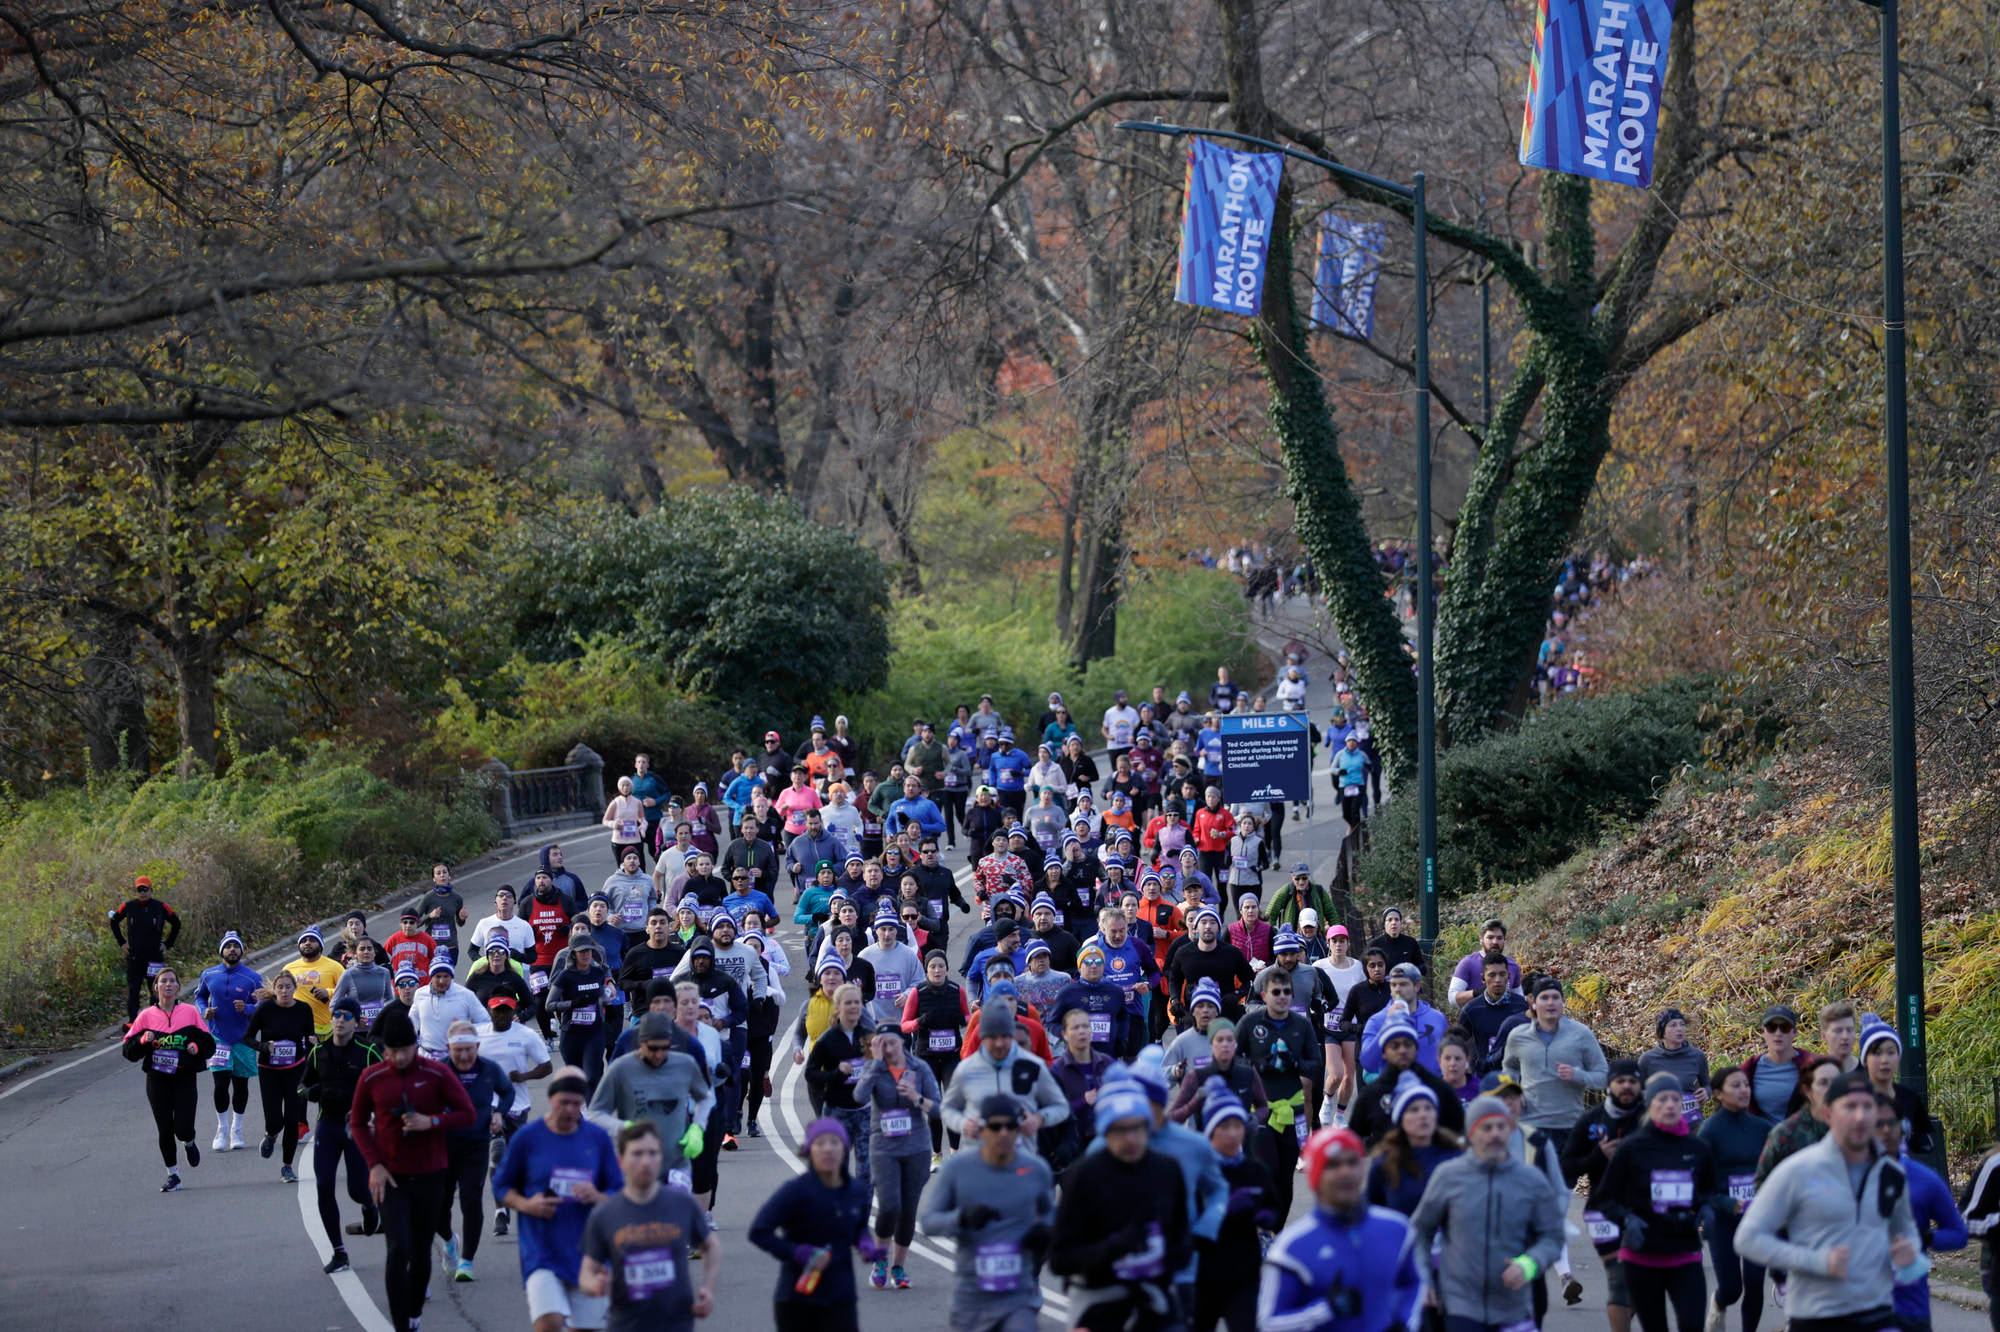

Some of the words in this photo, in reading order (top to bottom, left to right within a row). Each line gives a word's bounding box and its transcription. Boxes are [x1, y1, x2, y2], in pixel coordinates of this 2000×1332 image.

[1614, 39, 1659, 176] ROUTE
[1213, 153, 1253, 305] MARATHON
[1235, 218, 1265, 309] ROUTE
[1242, 717, 1275, 729] MILE
[1278, 716, 1288, 727] 6
[1277, 738, 1299, 746] several
[1255, 753, 1286, 761] University
